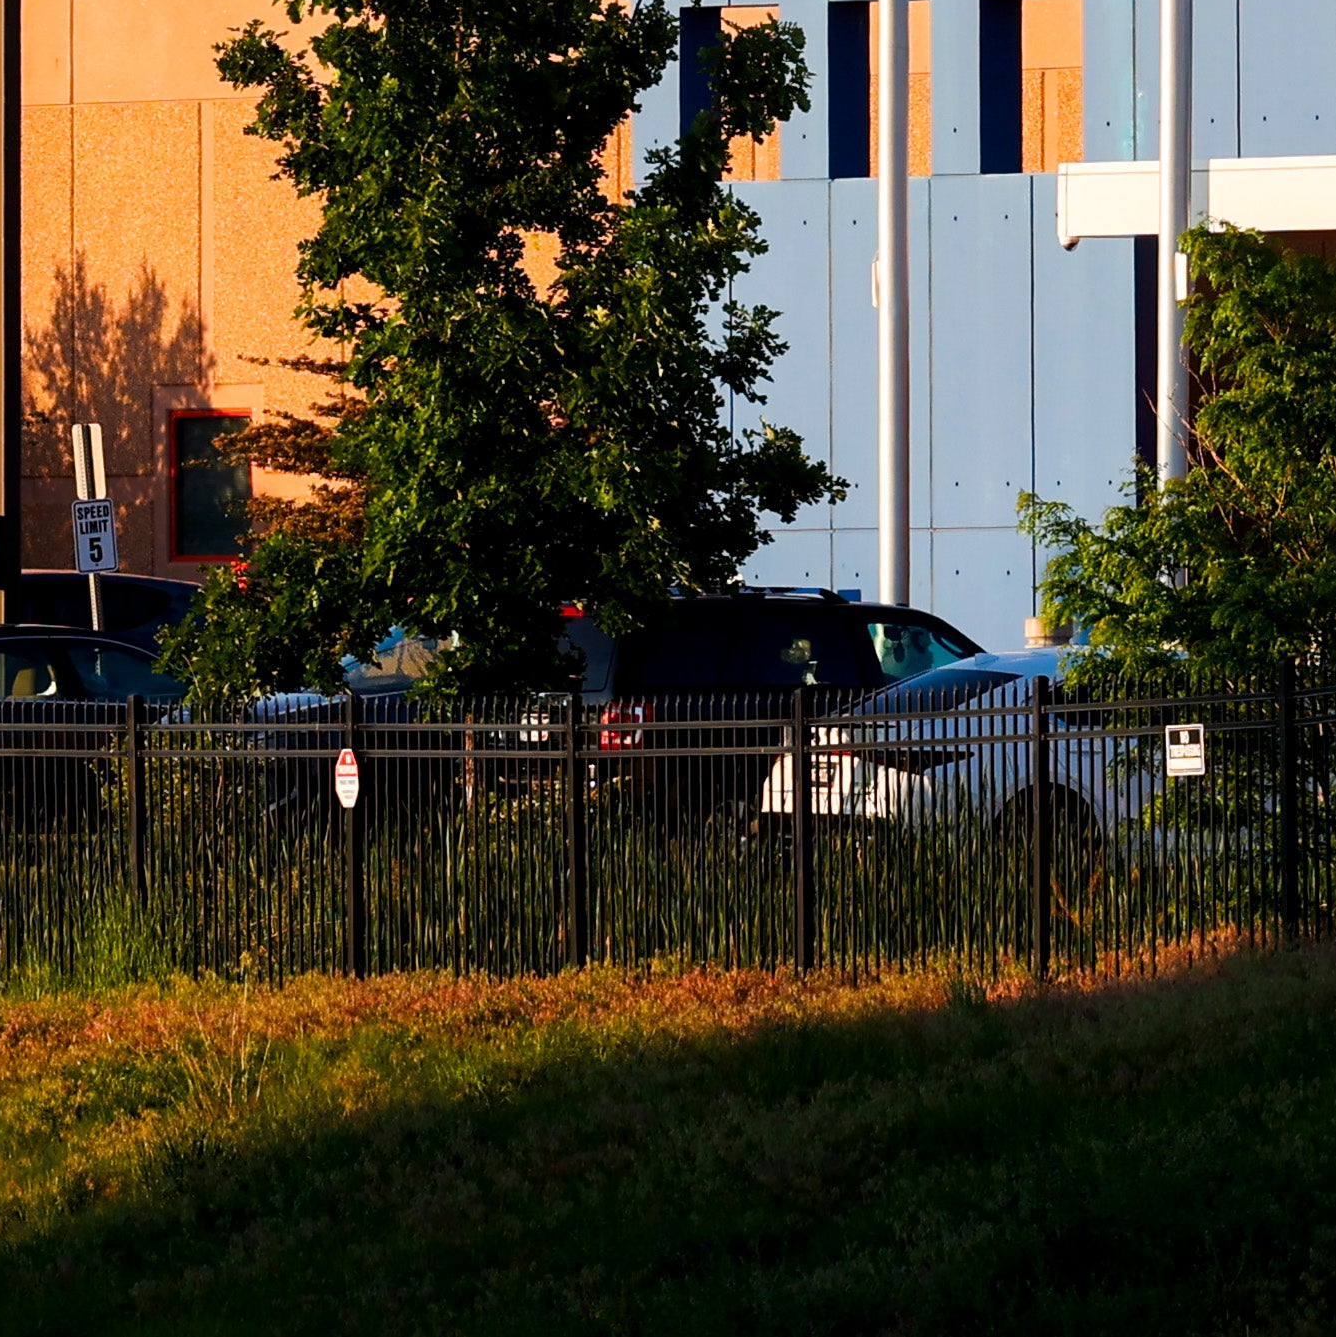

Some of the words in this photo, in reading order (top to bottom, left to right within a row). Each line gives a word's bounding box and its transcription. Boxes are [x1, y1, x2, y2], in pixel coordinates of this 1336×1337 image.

[77, 505, 110, 520] SPEED
[79, 520, 109, 535] LIMIT
[89, 537, 103, 563] 5
